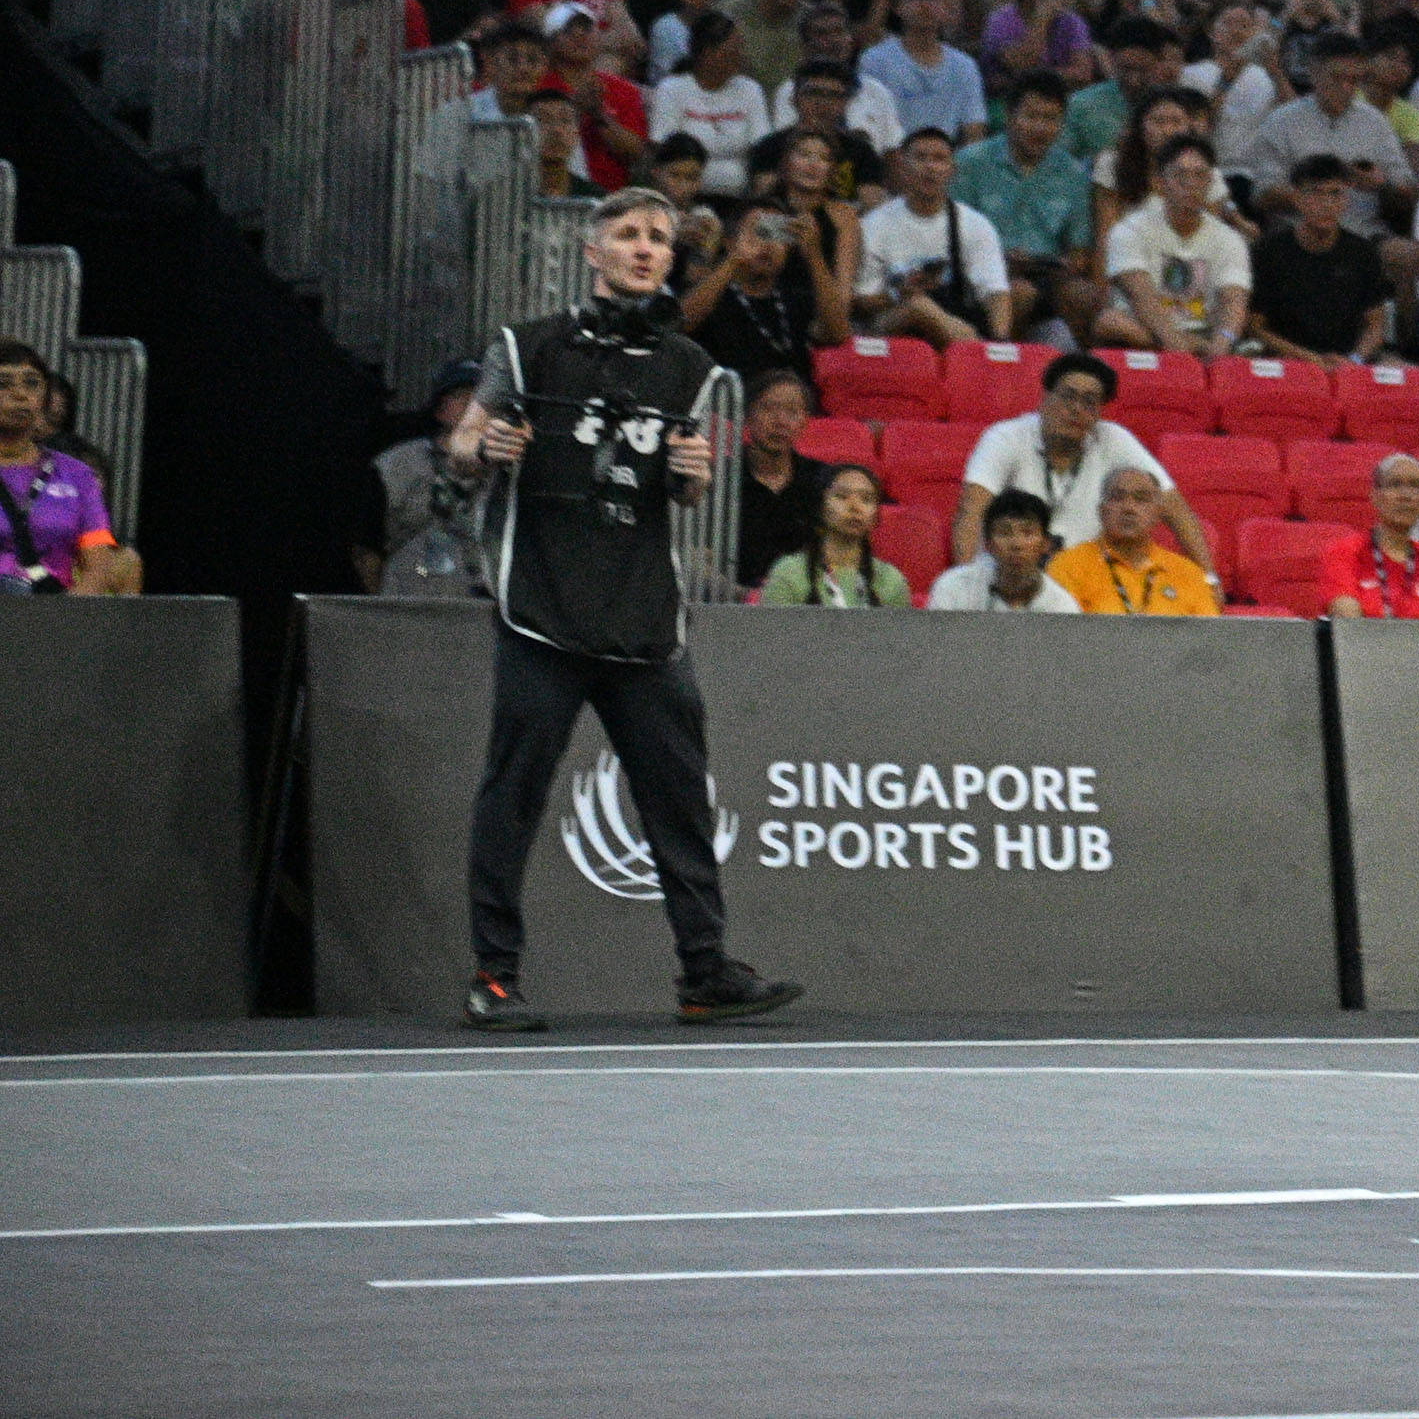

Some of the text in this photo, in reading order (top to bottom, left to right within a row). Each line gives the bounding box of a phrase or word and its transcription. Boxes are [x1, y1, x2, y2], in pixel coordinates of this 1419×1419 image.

[767, 761, 1100, 813] SINGAPORE
[758, 820, 1113, 872] SPORTS HUB
